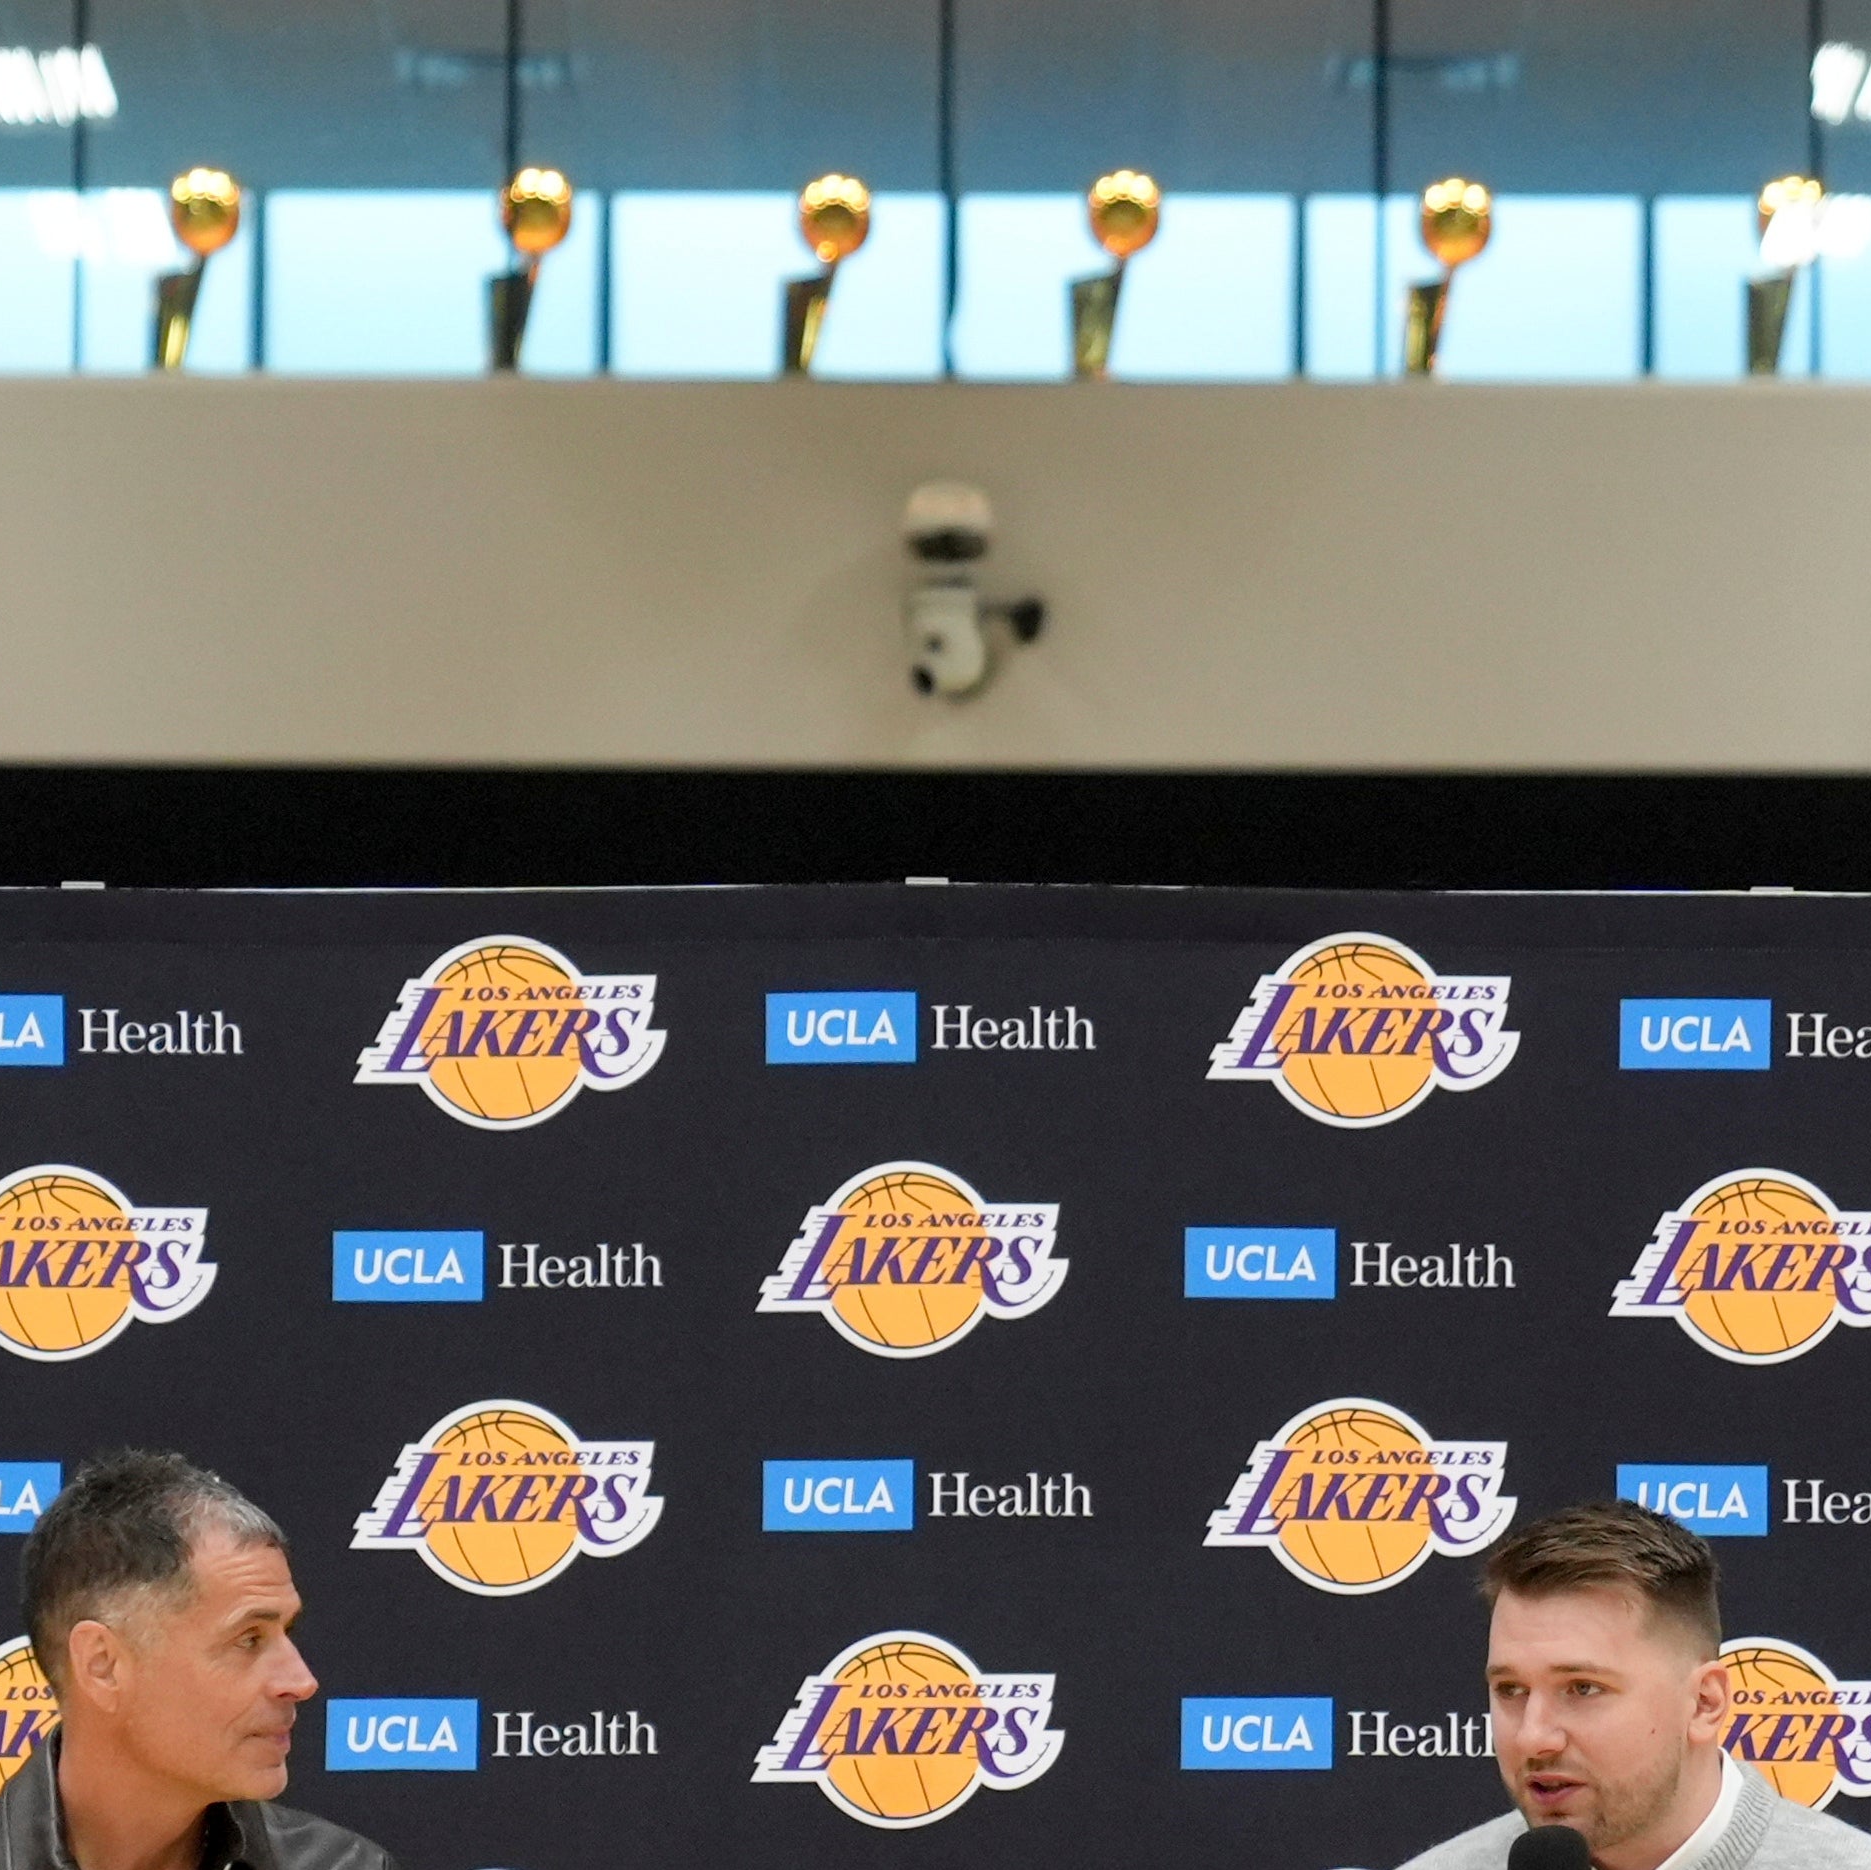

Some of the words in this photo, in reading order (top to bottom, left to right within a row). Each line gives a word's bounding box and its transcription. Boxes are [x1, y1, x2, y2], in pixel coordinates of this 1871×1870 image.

[1314, 982, 1365, 1000] LOS
[1369, 982, 1498, 1002] ANGELES
[79, 1010, 244, 1054] Health
[378, 987, 645, 1078] LAKERS
[787, 1009, 897, 1046] UCLA
[932, 1006, 1096, 1049] Health
[1231, 982, 1499, 1079] LAKERS
[1641, 1015, 1752, 1053] UCLA
[863, 1212, 914, 1229] LOS
[918, 1211, 1047, 1229] ANGELES
[354, 1248, 464, 1285] UCLA
[499, 1244, 663, 1287] Health
[781, 1214, 1048, 1307] LAKERS
[1206, 1244, 1316, 1282] UCLA
[1351, 1243, 1516, 1287] Health
[375, 1451, 643, 1545] LAKERS
[784, 1477, 894, 1514] UCLA
[929, 1473, 1093, 1516] Health
[1228, 1448, 1496, 1545] LAKERS
[859, 1682, 910, 1700] LOS
[914, 1681, 1043, 1699] ANGELES
[347, 1715, 458, 1753] UCLA
[493, 1711, 658, 1756] Health
[776, 1683, 1044, 1778] LAKERS
[1203, 1715, 1313, 1752] UCLA
